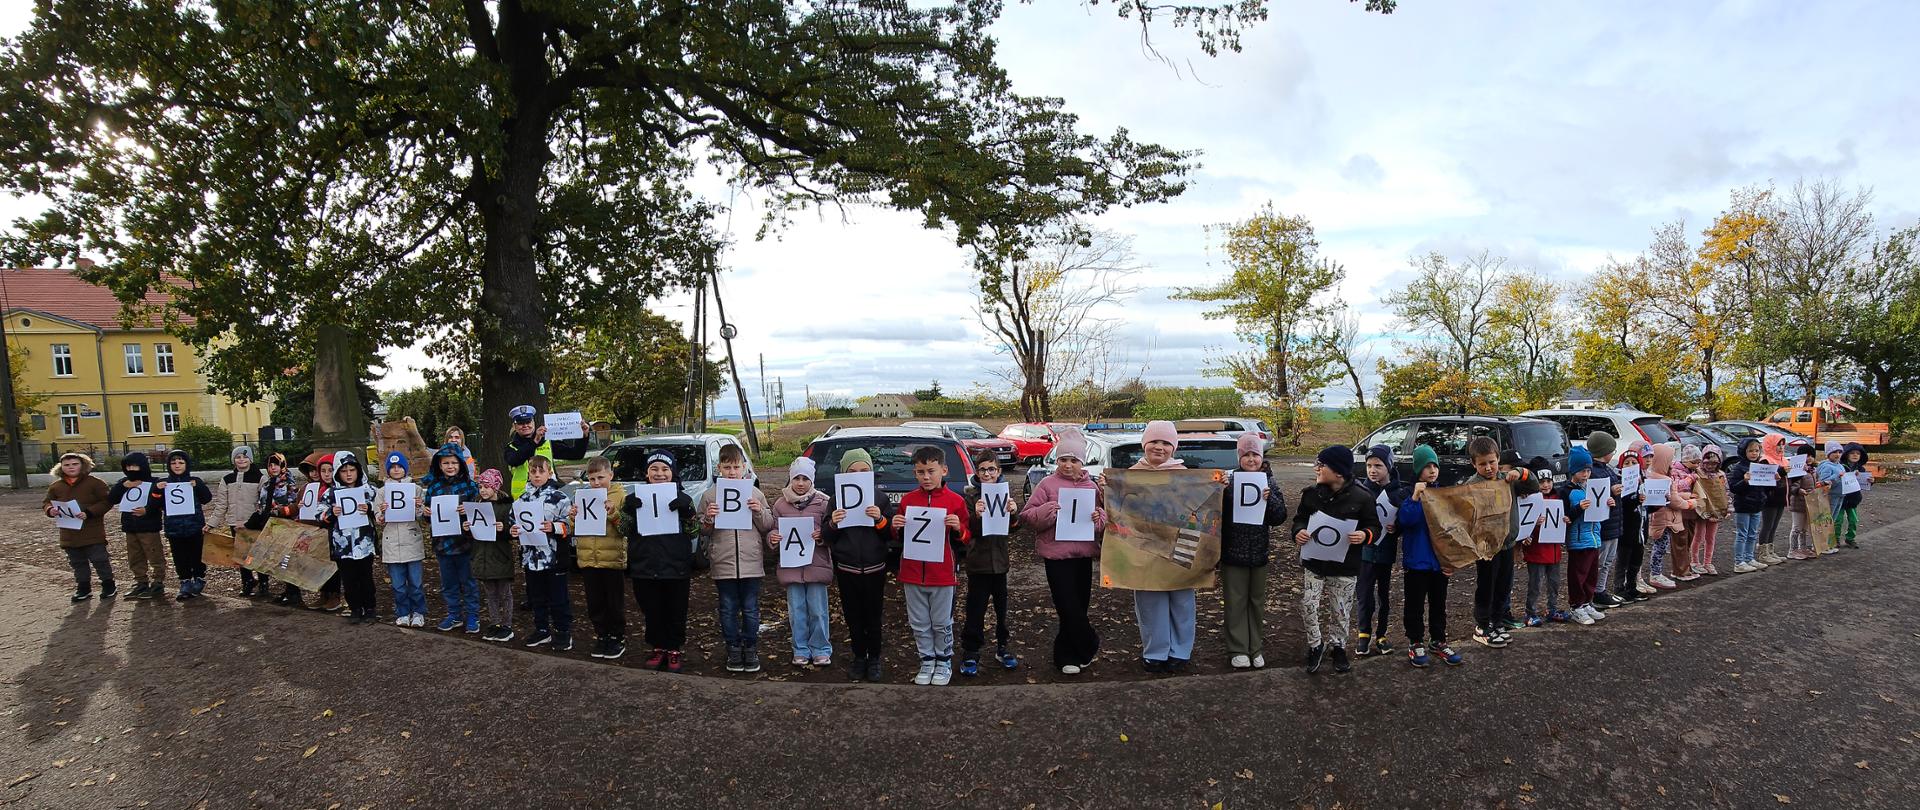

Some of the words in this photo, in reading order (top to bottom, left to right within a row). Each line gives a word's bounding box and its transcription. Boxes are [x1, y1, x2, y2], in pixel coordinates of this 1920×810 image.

[126, 486, 142, 502] O
[171, 485, 184, 505] Ś
[302, 489, 314, 507] O
[391, 490, 406, 509] B
[653, 493, 659, 517] I
[724, 489, 741, 513] B
[840, 484, 864, 510] D
[984, 492, 1009, 518] W
[1240, 483, 1262, 506] D
[1591, 487, 1606, 507] Y
[56, 502, 74, 519] N
[340, 496, 357, 517] D
[437, 503, 450, 523] L
[582, 498, 597, 521] K
[1071, 499, 1078, 524] I
[1519, 502, 1535, 526] Z
[1544, 507, 1560, 528] N
[472, 509, 489, 527] A
[518, 511, 535, 533] S
[911, 511, 932, 544] Ź
[784, 528, 805, 557] Ą
[1310, 525, 1341, 547] O
